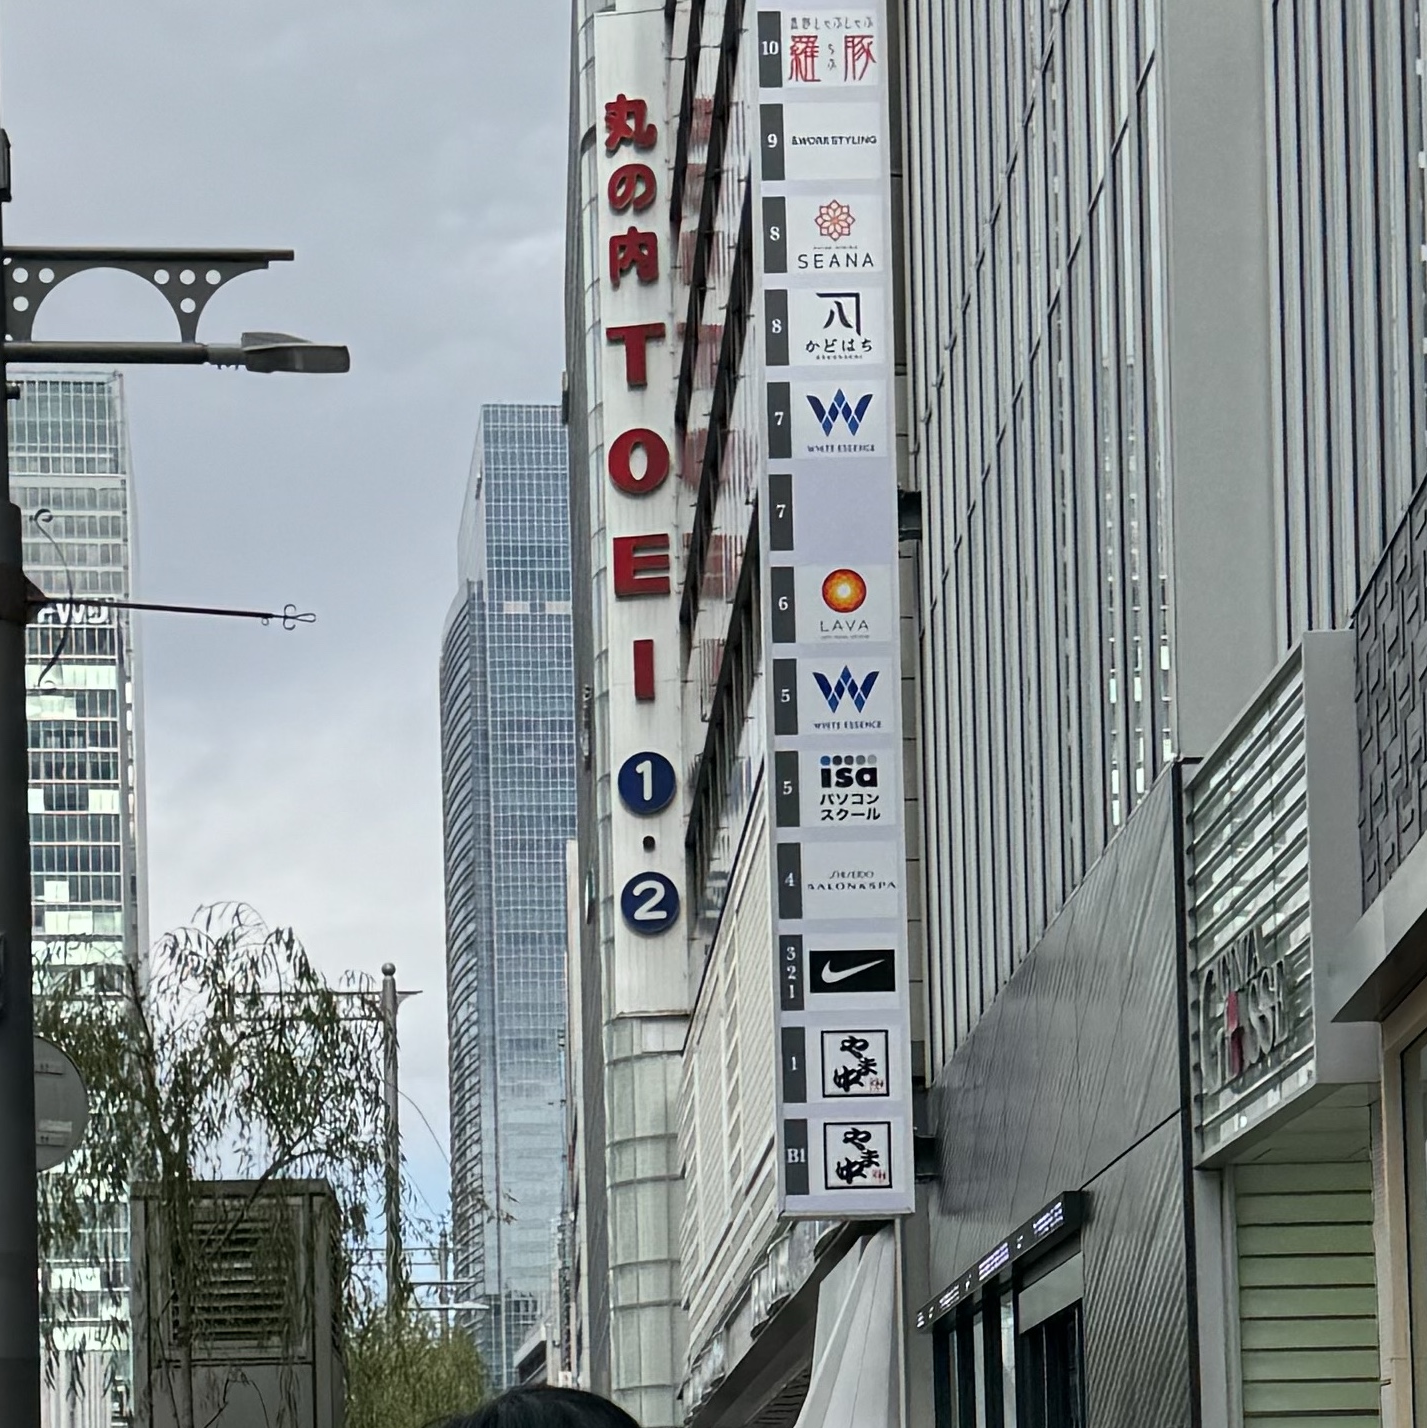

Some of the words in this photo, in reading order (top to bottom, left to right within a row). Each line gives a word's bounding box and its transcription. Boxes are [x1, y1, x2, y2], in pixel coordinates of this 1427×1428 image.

[762, 40, 779, 56] 10
[767, 133, 778, 148] 9
[605, 93, 659, 289] 丸の内
[769, 226, 780, 241] 8
[798, 252, 875, 269] SEANA
[771, 318, 782, 334] 8
[806, 338, 873, 353] かどはち
[774, 411, 784, 426] 7
[605, 322, 672, 702] TOEI
[776, 504, 786, 519] 7
[778, 596, 789, 611] 6
[820, 619, 869, 632] LAVA
[780, 688, 791, 703] 5
[820, 754, 878, 789] isa
[783, 780, 793, 796] 5
[820, 793, 880, 806] パソコン
[820, 807, 881, 821] スクール
[784, 872, 795, 887] 4
[786, 946, 796, 961] 3
[786, 966, 797, 980] 2
[788, 984, 796, 999] 1
[791, 1056, 798, 1072] 1
[787, 1147, 806, 1164] B1
